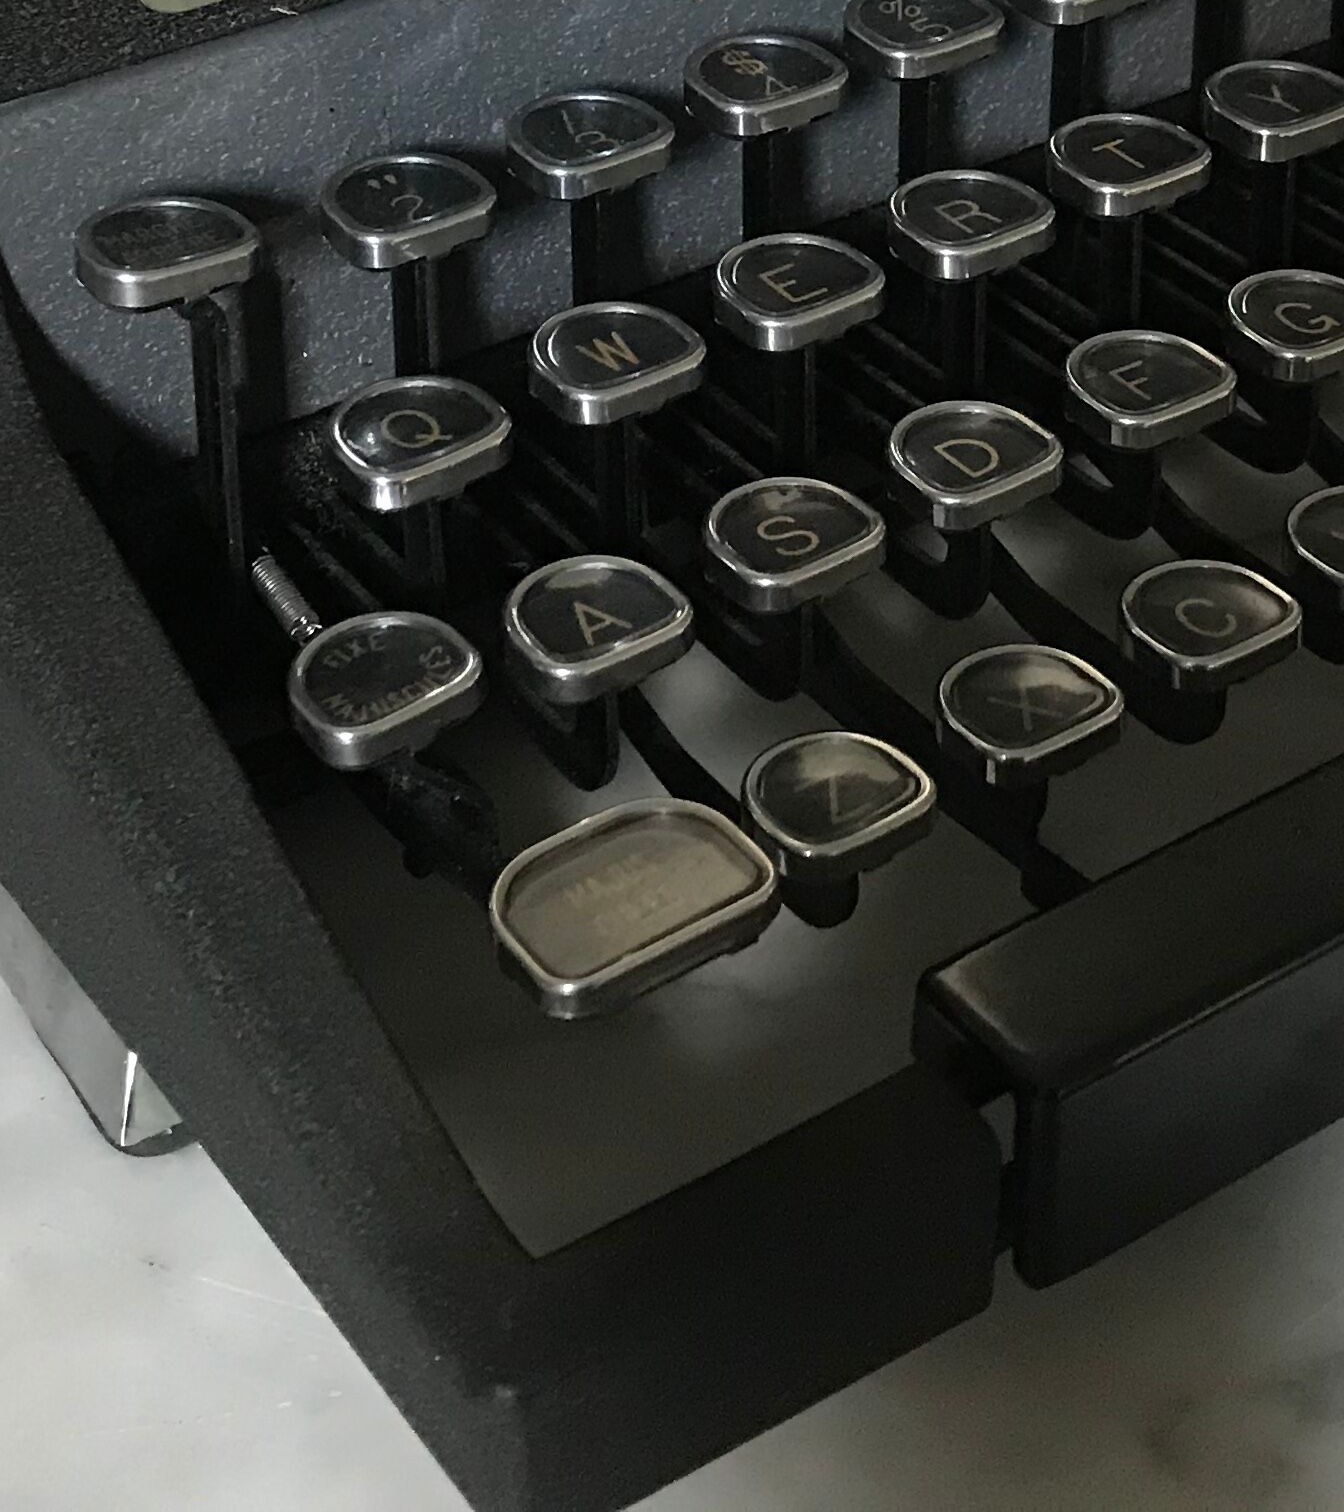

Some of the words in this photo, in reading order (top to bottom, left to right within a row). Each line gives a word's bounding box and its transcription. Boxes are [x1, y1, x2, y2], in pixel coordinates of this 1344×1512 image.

[909, 17, 953, 42] 5
[722, 49, 768, 76] $
[1248, 83, 1300, 113] Y
[1092, 138, 1145, 169] T
[933, 199, 1002, 233] R
[759, 262, 828, 303] E
[1273, 301, 1343, 334] G
[575, 330, 639, 372] W
[1109, 359, 1152, 401] F
[380, 408, 453, 449] Q
[933, 437, 1000, 479] D
[757, 515, 820, 556] S
[573, 600, 632, 646] A
[1174, 597, 1237, 638] C
[325, 630, 388, 669] FIXE
[986, 686, 1065, 732] X
[794, 775, 869, 825] Z
